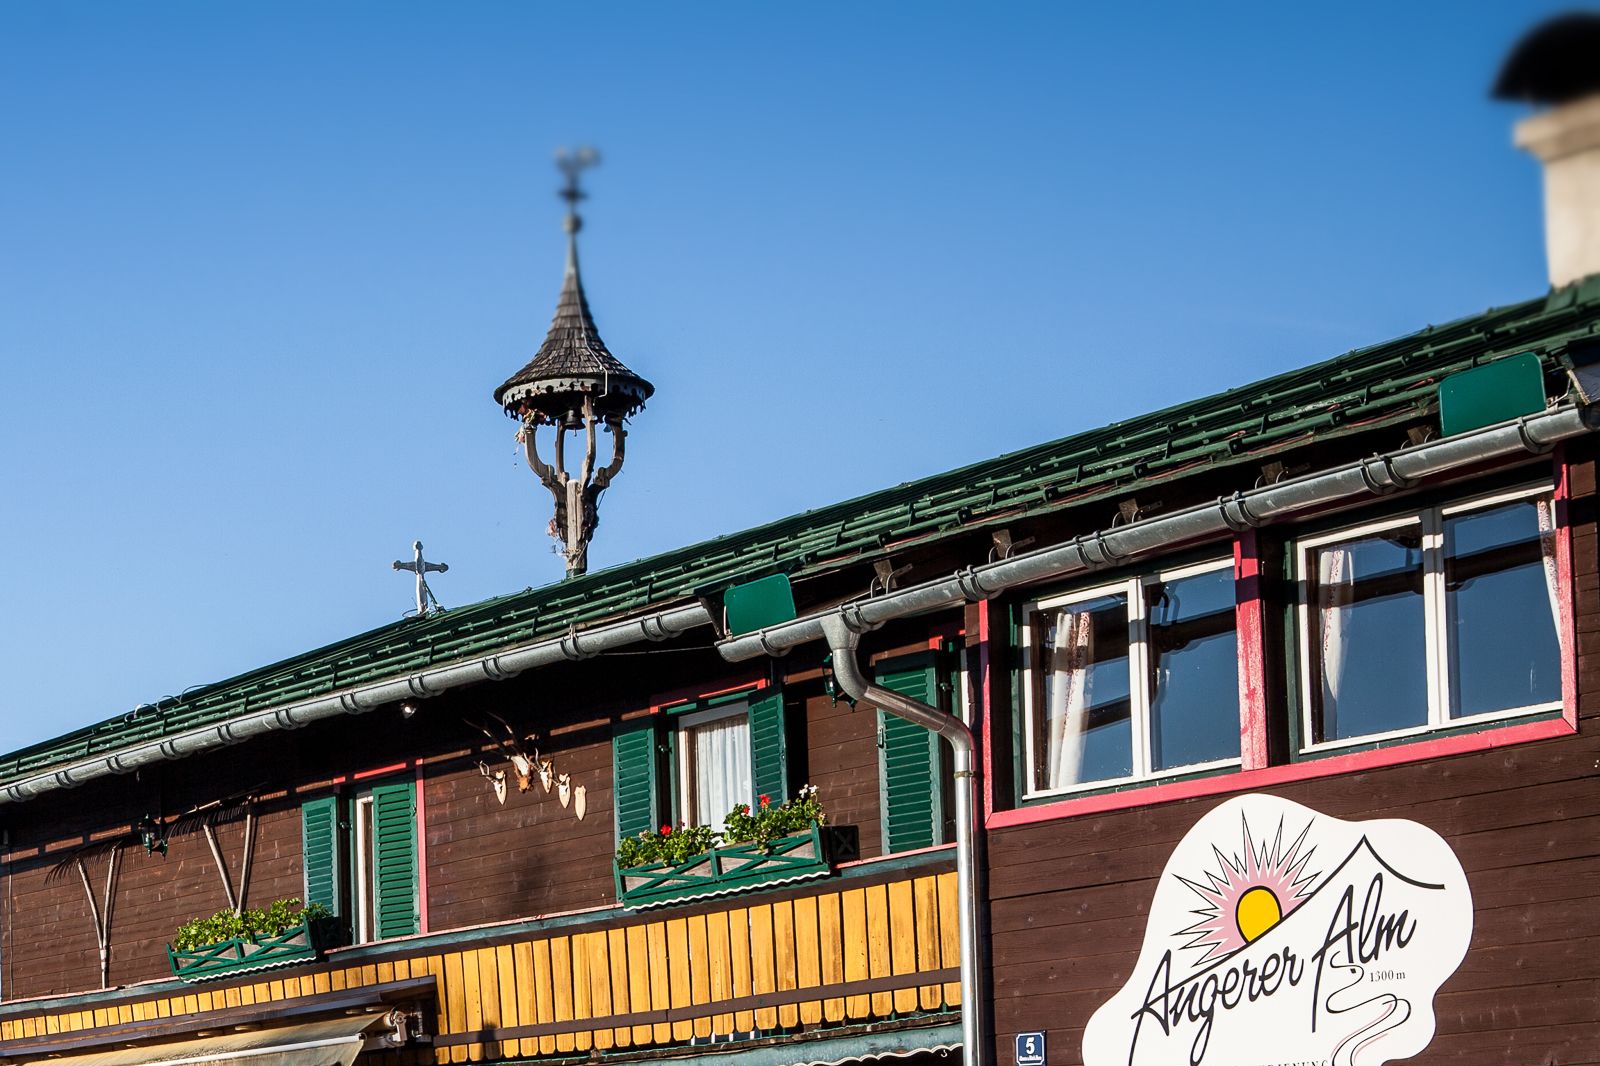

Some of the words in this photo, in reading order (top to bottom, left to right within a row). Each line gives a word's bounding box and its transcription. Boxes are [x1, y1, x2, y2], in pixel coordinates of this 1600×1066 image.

[1311, 872, 1417, 1033] Alm
[1396, 971, 1406, 980] m
[1025, 1036, 1035, 1055] 5
